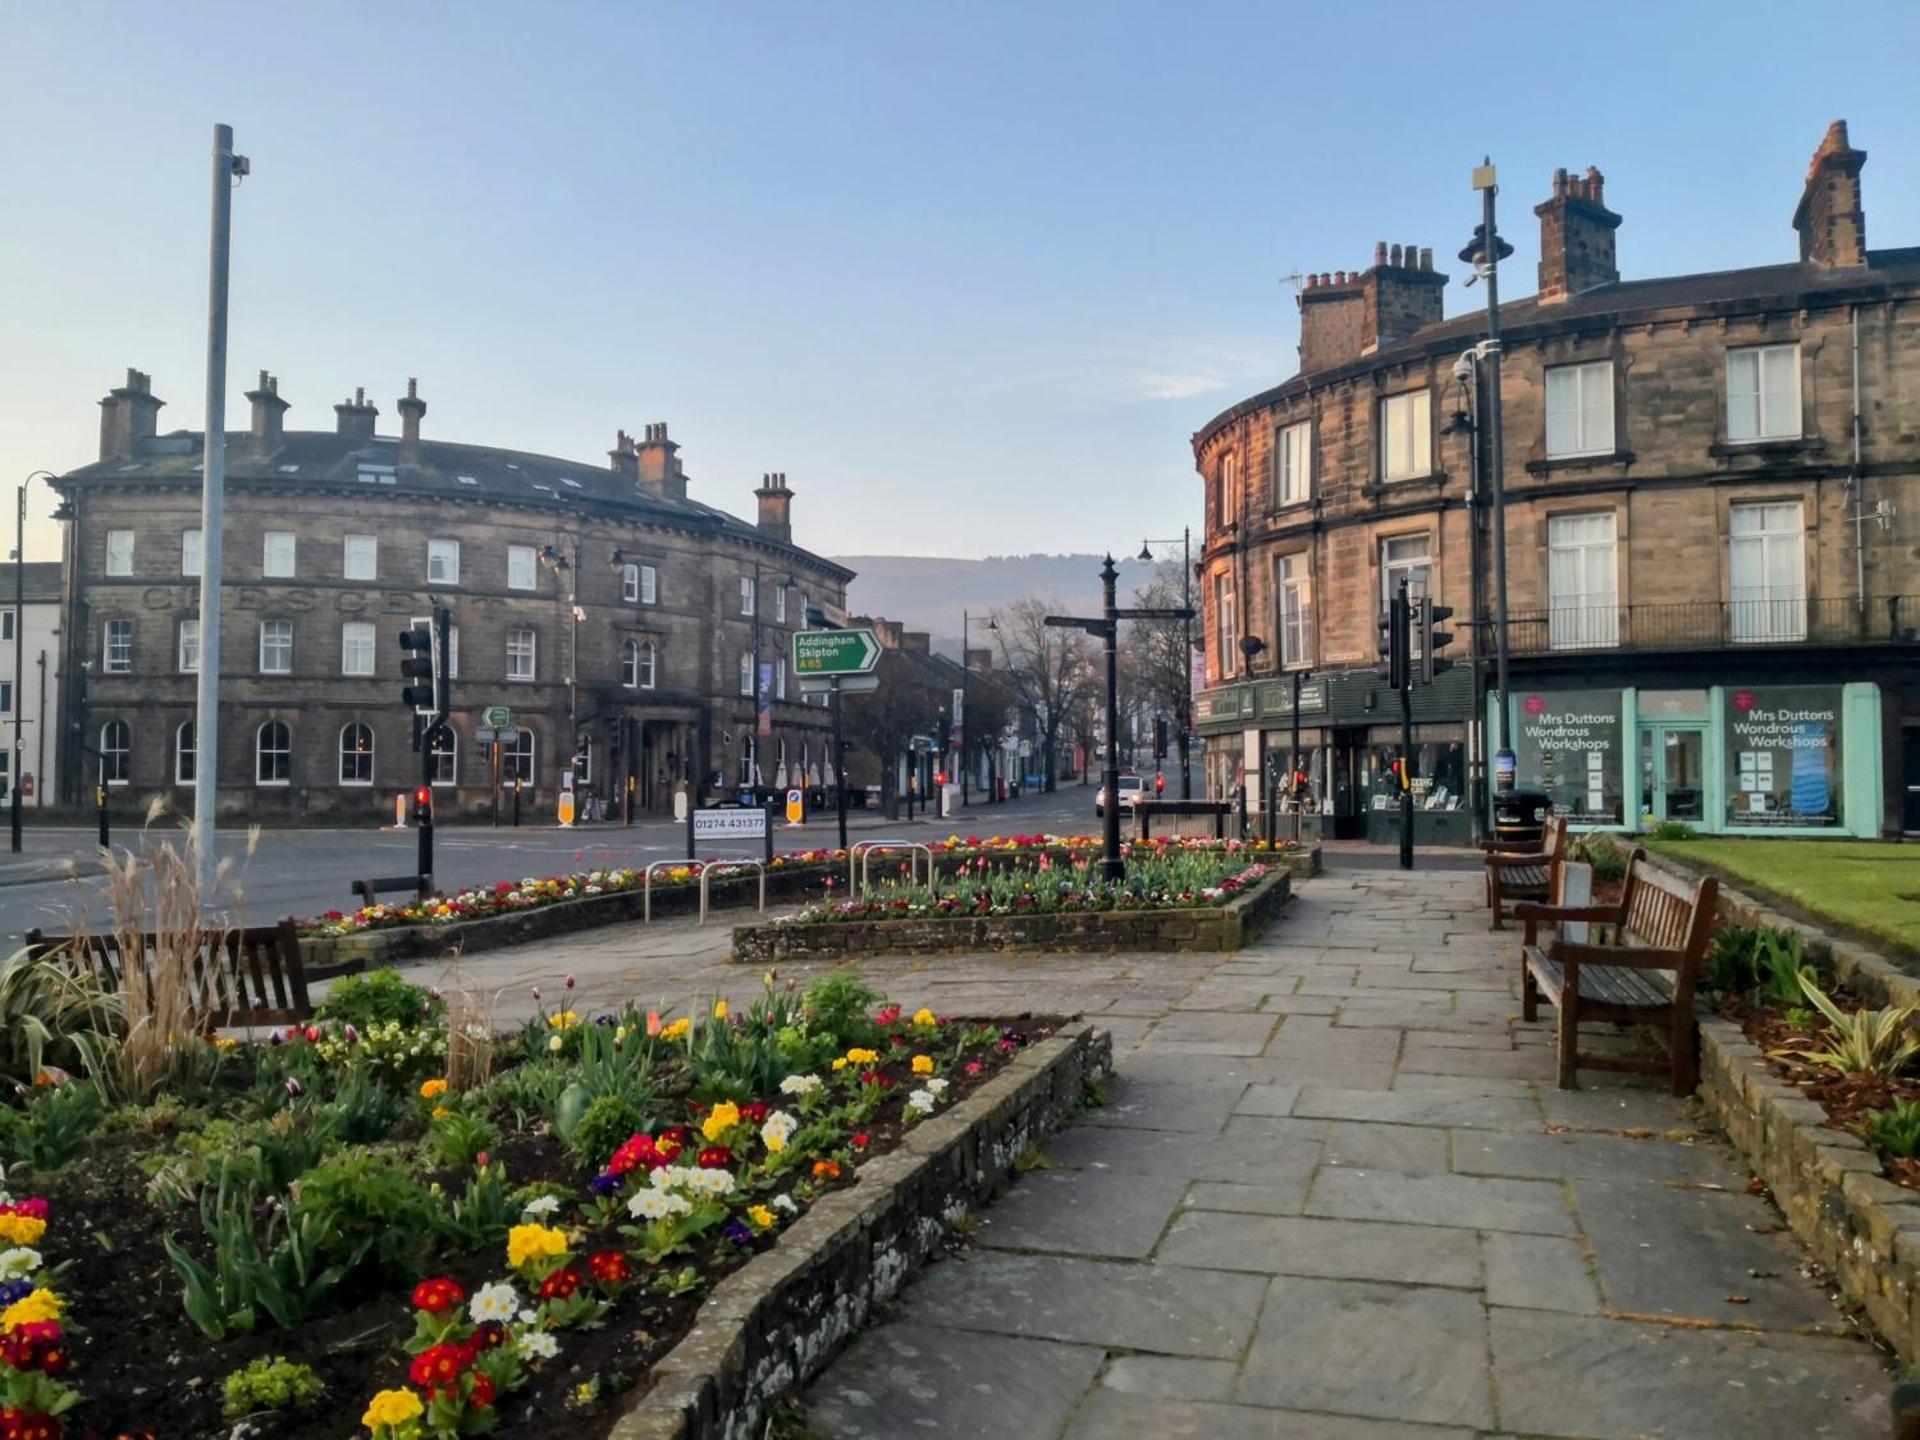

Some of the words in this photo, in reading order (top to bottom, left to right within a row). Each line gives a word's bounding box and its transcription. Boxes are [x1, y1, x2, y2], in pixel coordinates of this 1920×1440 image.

[798, 636, 856, 648] Addingham
[798, 647, 839, 658] Skipton
[1539, 713, 1563, 725] Mrs
[1565, 713, 1616, 724] Duttons
[1749, 709, 1776, 721] Mrs
[1778, 709, 1834, 721] Duttons
[1525, 726, 1590, 737] Wondrous
[1733, 722, 1806, 734] Wondrous
[1539, 738, 1610, 751] Workshops
[1748, 735, 1828, 749] Workshops
[695, 819, 726, 829] 01274
[728, 818, 764, 828] 431377
